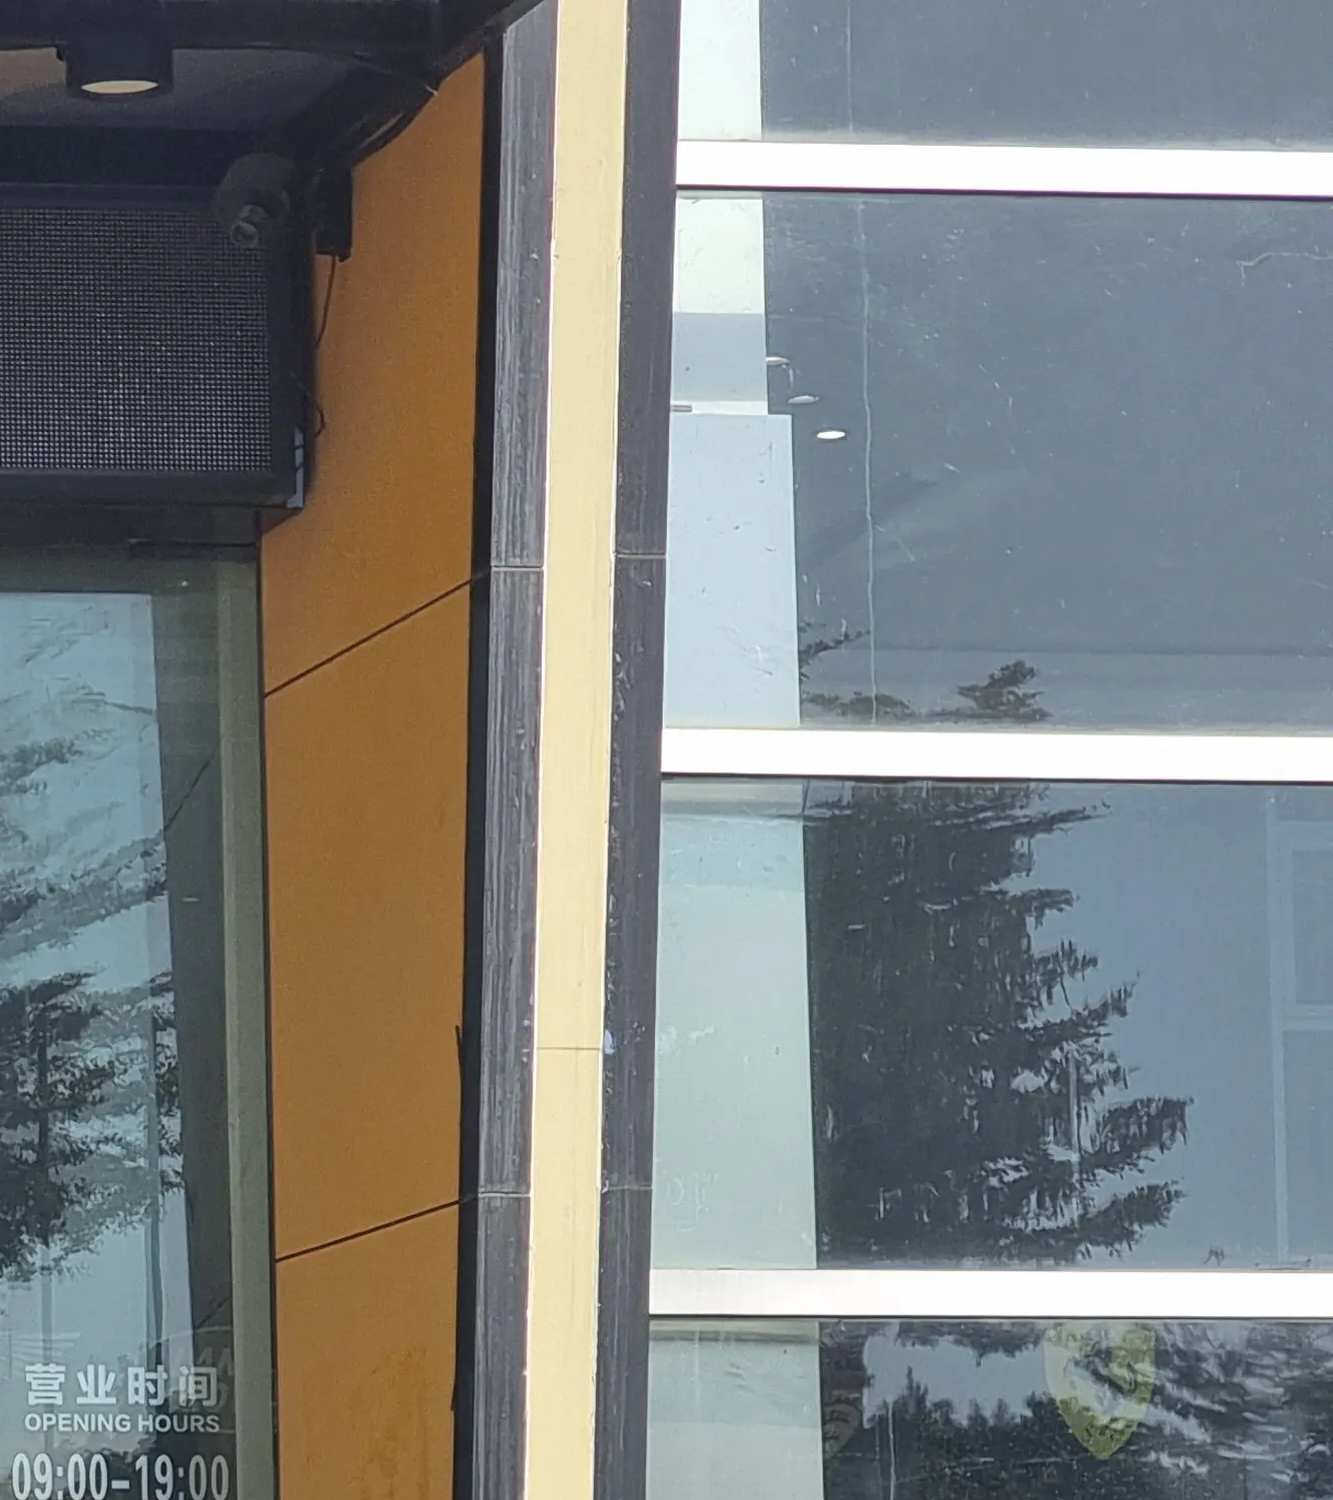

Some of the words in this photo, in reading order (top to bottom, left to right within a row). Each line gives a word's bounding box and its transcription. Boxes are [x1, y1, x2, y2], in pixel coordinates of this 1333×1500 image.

[24, 1362, 218, 1407] 营业时间
[24, 1413, 131, 1432] OPENING
[138, 1413, 220, 1432] HOURS
